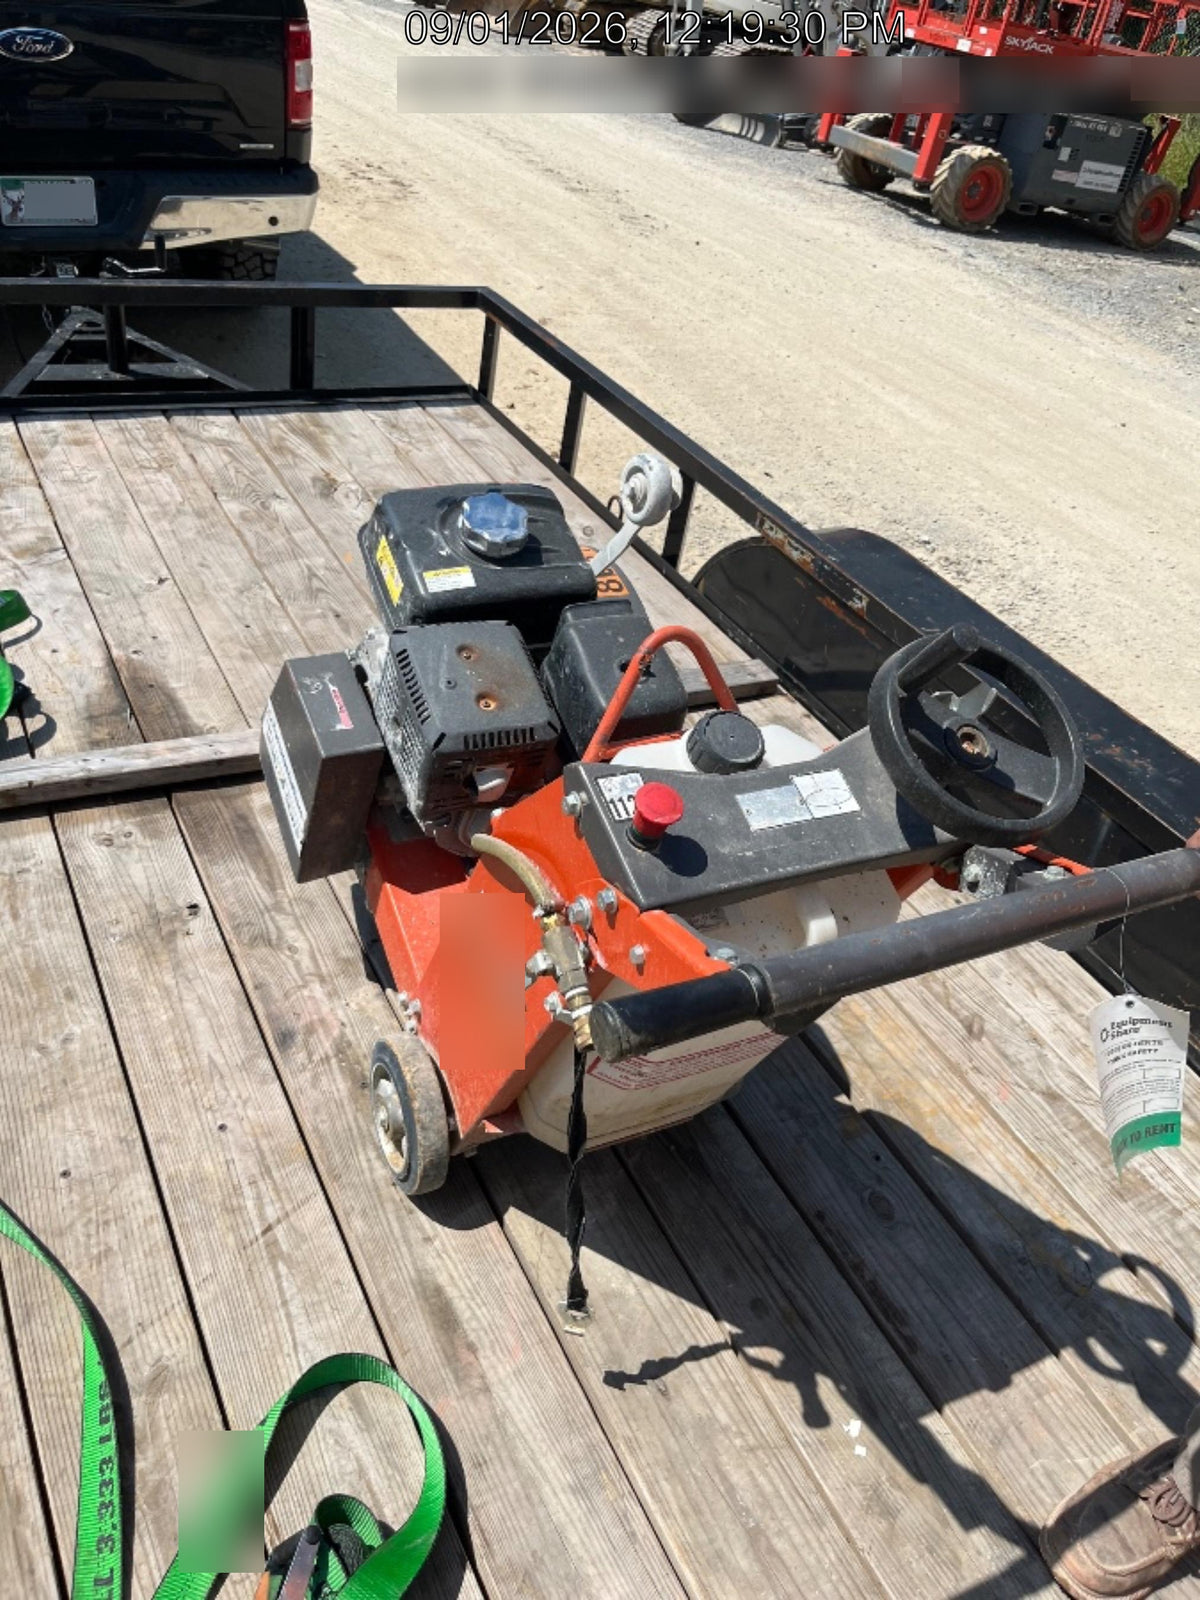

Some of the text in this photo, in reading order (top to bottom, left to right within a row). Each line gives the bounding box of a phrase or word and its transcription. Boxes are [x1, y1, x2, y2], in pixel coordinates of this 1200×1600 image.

[13, 35, 55, 53] Ford
[1005, 36, 1054, 54] SKYJACK
[1145, 1123, 1176, 1138] RENT
[96, 1455, 118, 1554] 3,333
